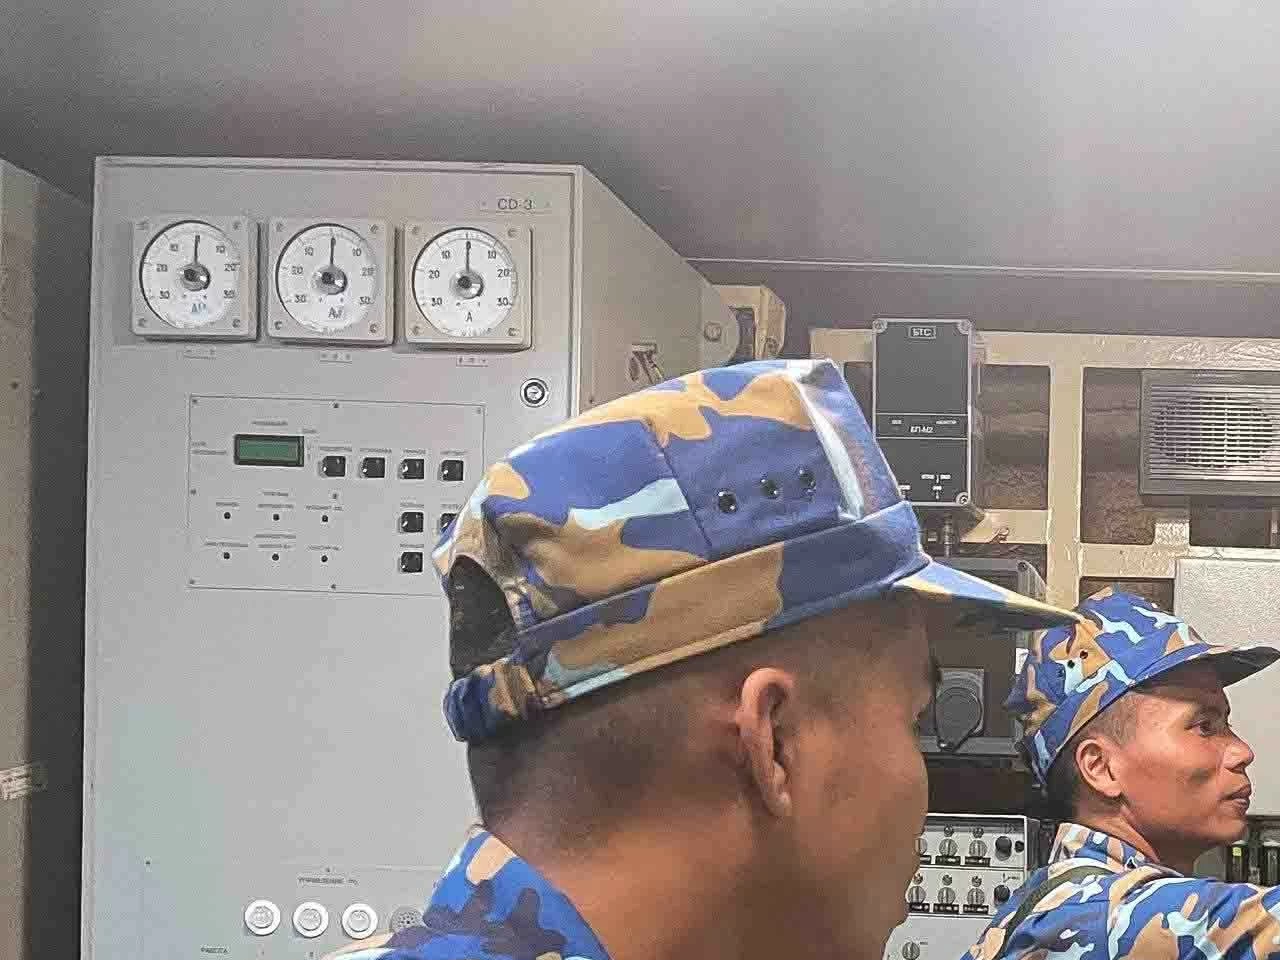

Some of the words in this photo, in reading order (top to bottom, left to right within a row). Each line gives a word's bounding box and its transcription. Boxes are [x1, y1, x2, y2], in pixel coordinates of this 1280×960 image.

[441, 251, 450, 259] 10
[487, 251, 497, 259] 10
[428, 270, 440, 279] 20
[497, 269, 510, 278] 20
[431, 297, 442, 306] 30
[497, 297, 509, 306] 30
